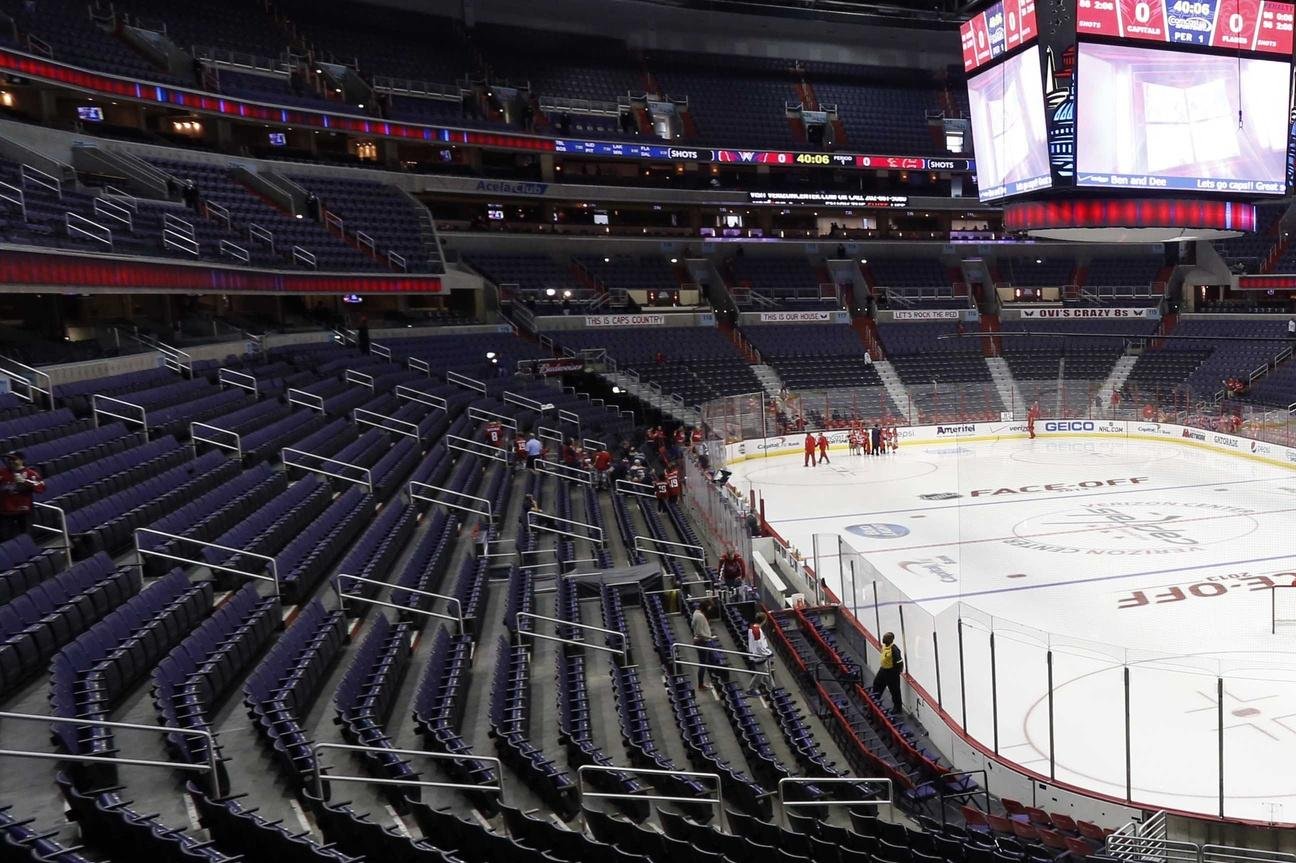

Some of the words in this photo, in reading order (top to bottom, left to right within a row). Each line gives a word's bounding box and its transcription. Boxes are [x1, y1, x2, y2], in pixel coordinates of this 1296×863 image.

[1135, 2, 1150, 22] 0
[1174, 0, 1210, 15] 40:06
[1008, 12, 1016, 32] 0
[1230, 14, 1243, 33] 0
[978, 30, 985, 48] 0
[1174, 34, 1192, 42] PER
[671, 150, 698, 158] SHOTS
[778, 154, 786, 163] 0
[796, 154, 830, 164] 40:06
[863, 157, 870, 166] 0
[1110, 176, 1128, 185] Ben
[1130, 177, 1147, 186] and
[1148, 178, 1166, 186] Dee
[1196, 180, 1214, 188] Lets
[1216, 182, 1226, 190] go
[1256, 182, 1278, 191] Great
[477, 181, 510, 192] Acela
[1040, 310, 1070, 318] OVI'S
[1074, 309, 1110, 317] CRAZY
[612, 316, 628, 324] CAPS
[632, 316, 664, 324] COUNTRY
[937, 424, 976, 434] Ameritel
[1045, 422, 1094, 432] GEICO
[491, 432, 498, 442] 8
[898, 430, 914, 438] epsi
[1214, 436, 1238, 448] GATORADE
[970, 476, 1149, 498] FACE-OFF
[1205, 572, 1252, 582] 2013
